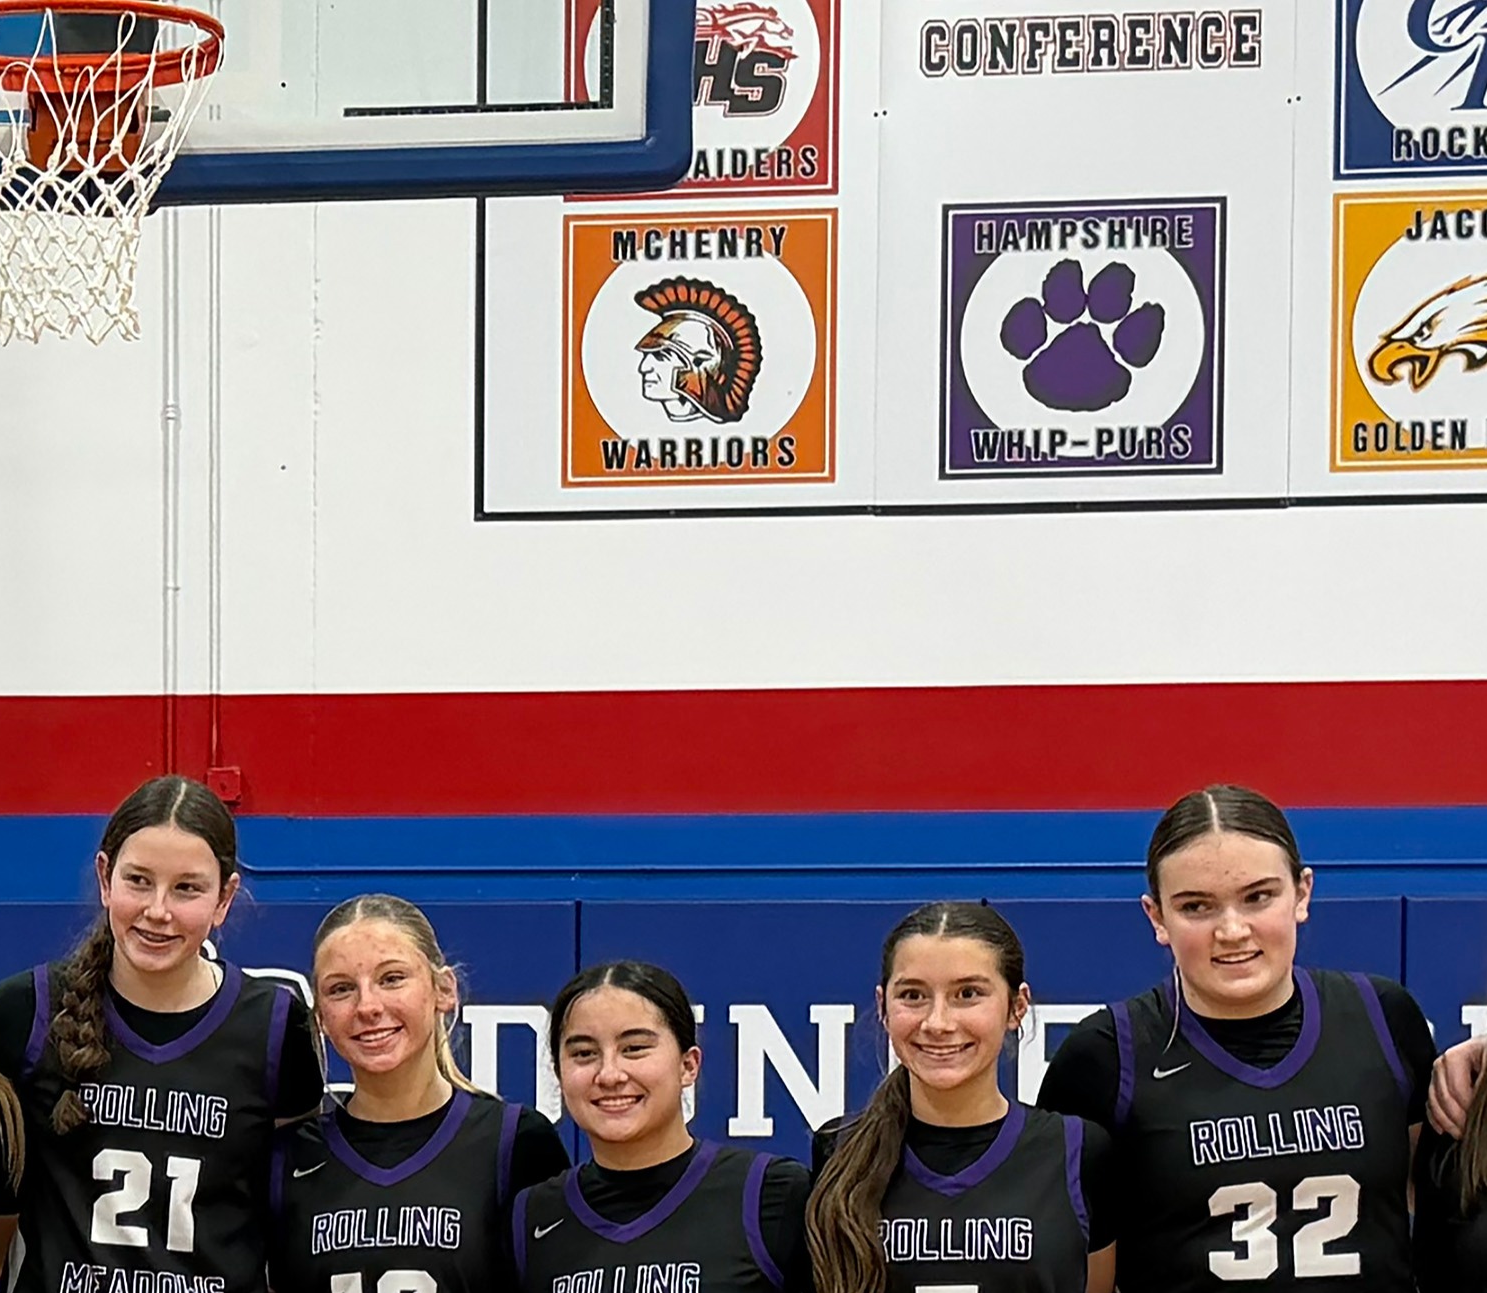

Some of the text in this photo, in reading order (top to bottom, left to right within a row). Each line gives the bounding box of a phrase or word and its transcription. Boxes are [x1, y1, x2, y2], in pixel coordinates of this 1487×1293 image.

[920, 10, 1262, 77] CONFERENCE
[693, 146, 818, 181] AIDERS
[612, 225, 786, 262] MCHENRY
[975, 216, 1194, 254] HAMPSHIRE
[599, 436, 797, 471] WARRIORS
[970, 424, 1193, 464] WHIP-PURS
[1353, 418, 1472, 454] GOLDEN
[77, 1082, 228, 1139] ROLLING
[1189, 1105, 1365, 1167] ROLLING
[90, 1148, 202, 1253] 21
[312, 1206, 461, 1255] ROLLING
[1207, 1174, 1362, 1281] 32
